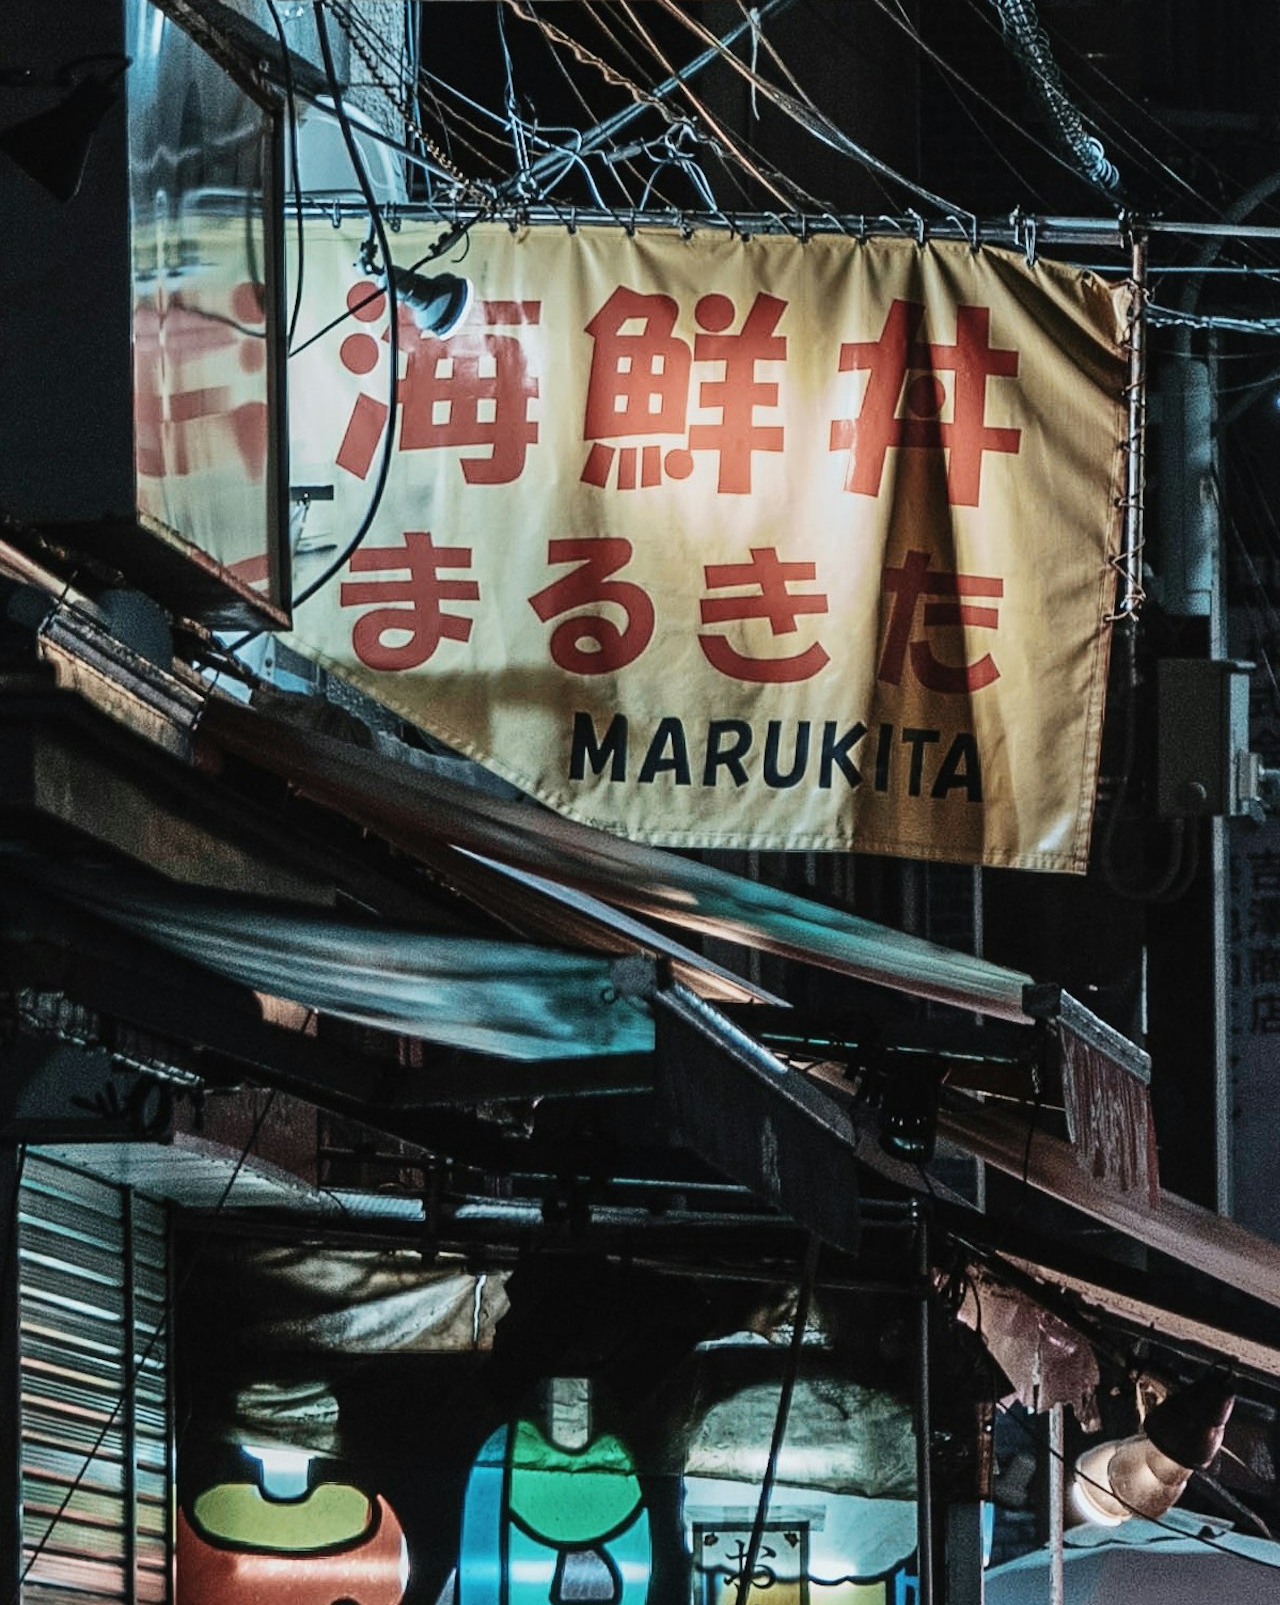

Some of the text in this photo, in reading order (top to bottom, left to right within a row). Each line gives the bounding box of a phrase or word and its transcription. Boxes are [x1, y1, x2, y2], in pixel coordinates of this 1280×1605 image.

[334, 278, 1022, 509] 海鮮丼
[336, 531, 1006, 697] まるきた
[567, 708, 985, 805] MARUKITA
